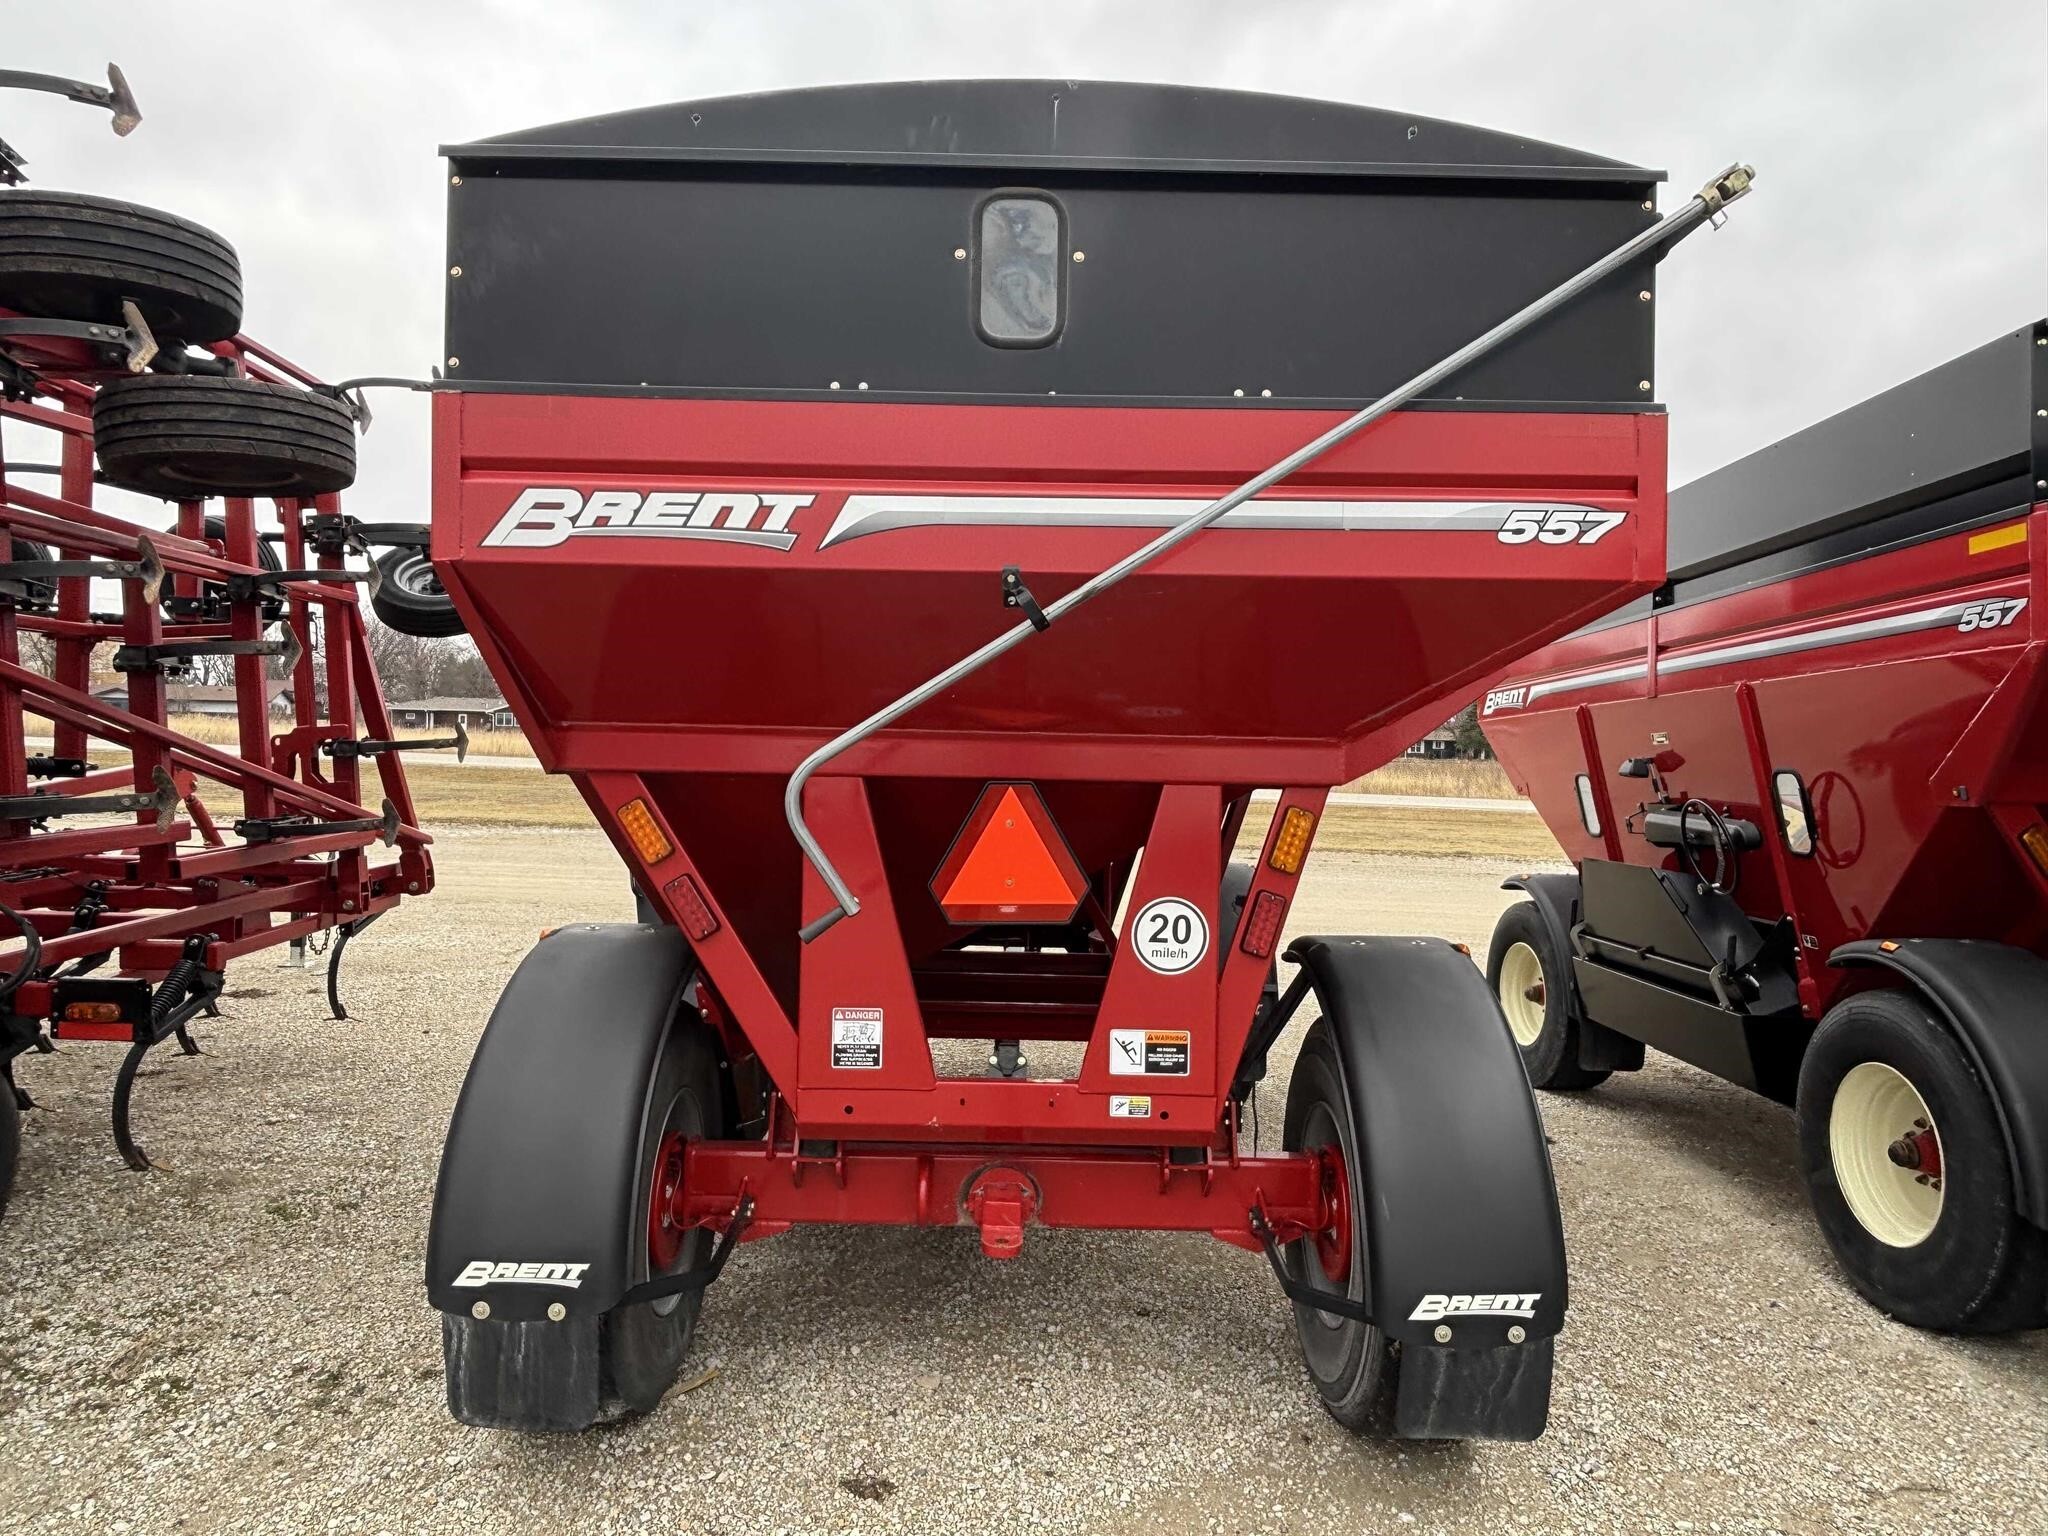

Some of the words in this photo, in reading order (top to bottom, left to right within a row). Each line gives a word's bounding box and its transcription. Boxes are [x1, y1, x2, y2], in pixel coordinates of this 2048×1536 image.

[480, 488, 817, 551] BRENT
[1497, 509, 1629, 545] 557
[1957, 597, 2029, 633] 557
[1482, 687, 1527, 716] BRENT
[1148, 913, 1192, 945] 20
[1151, 947, 1188, 959] mile/h
[845, 1011, 880, 1020] DANGER
[451, 1261, 591, 1289] BRENT
[1407, 1293, 1542, 1321] BRENT
